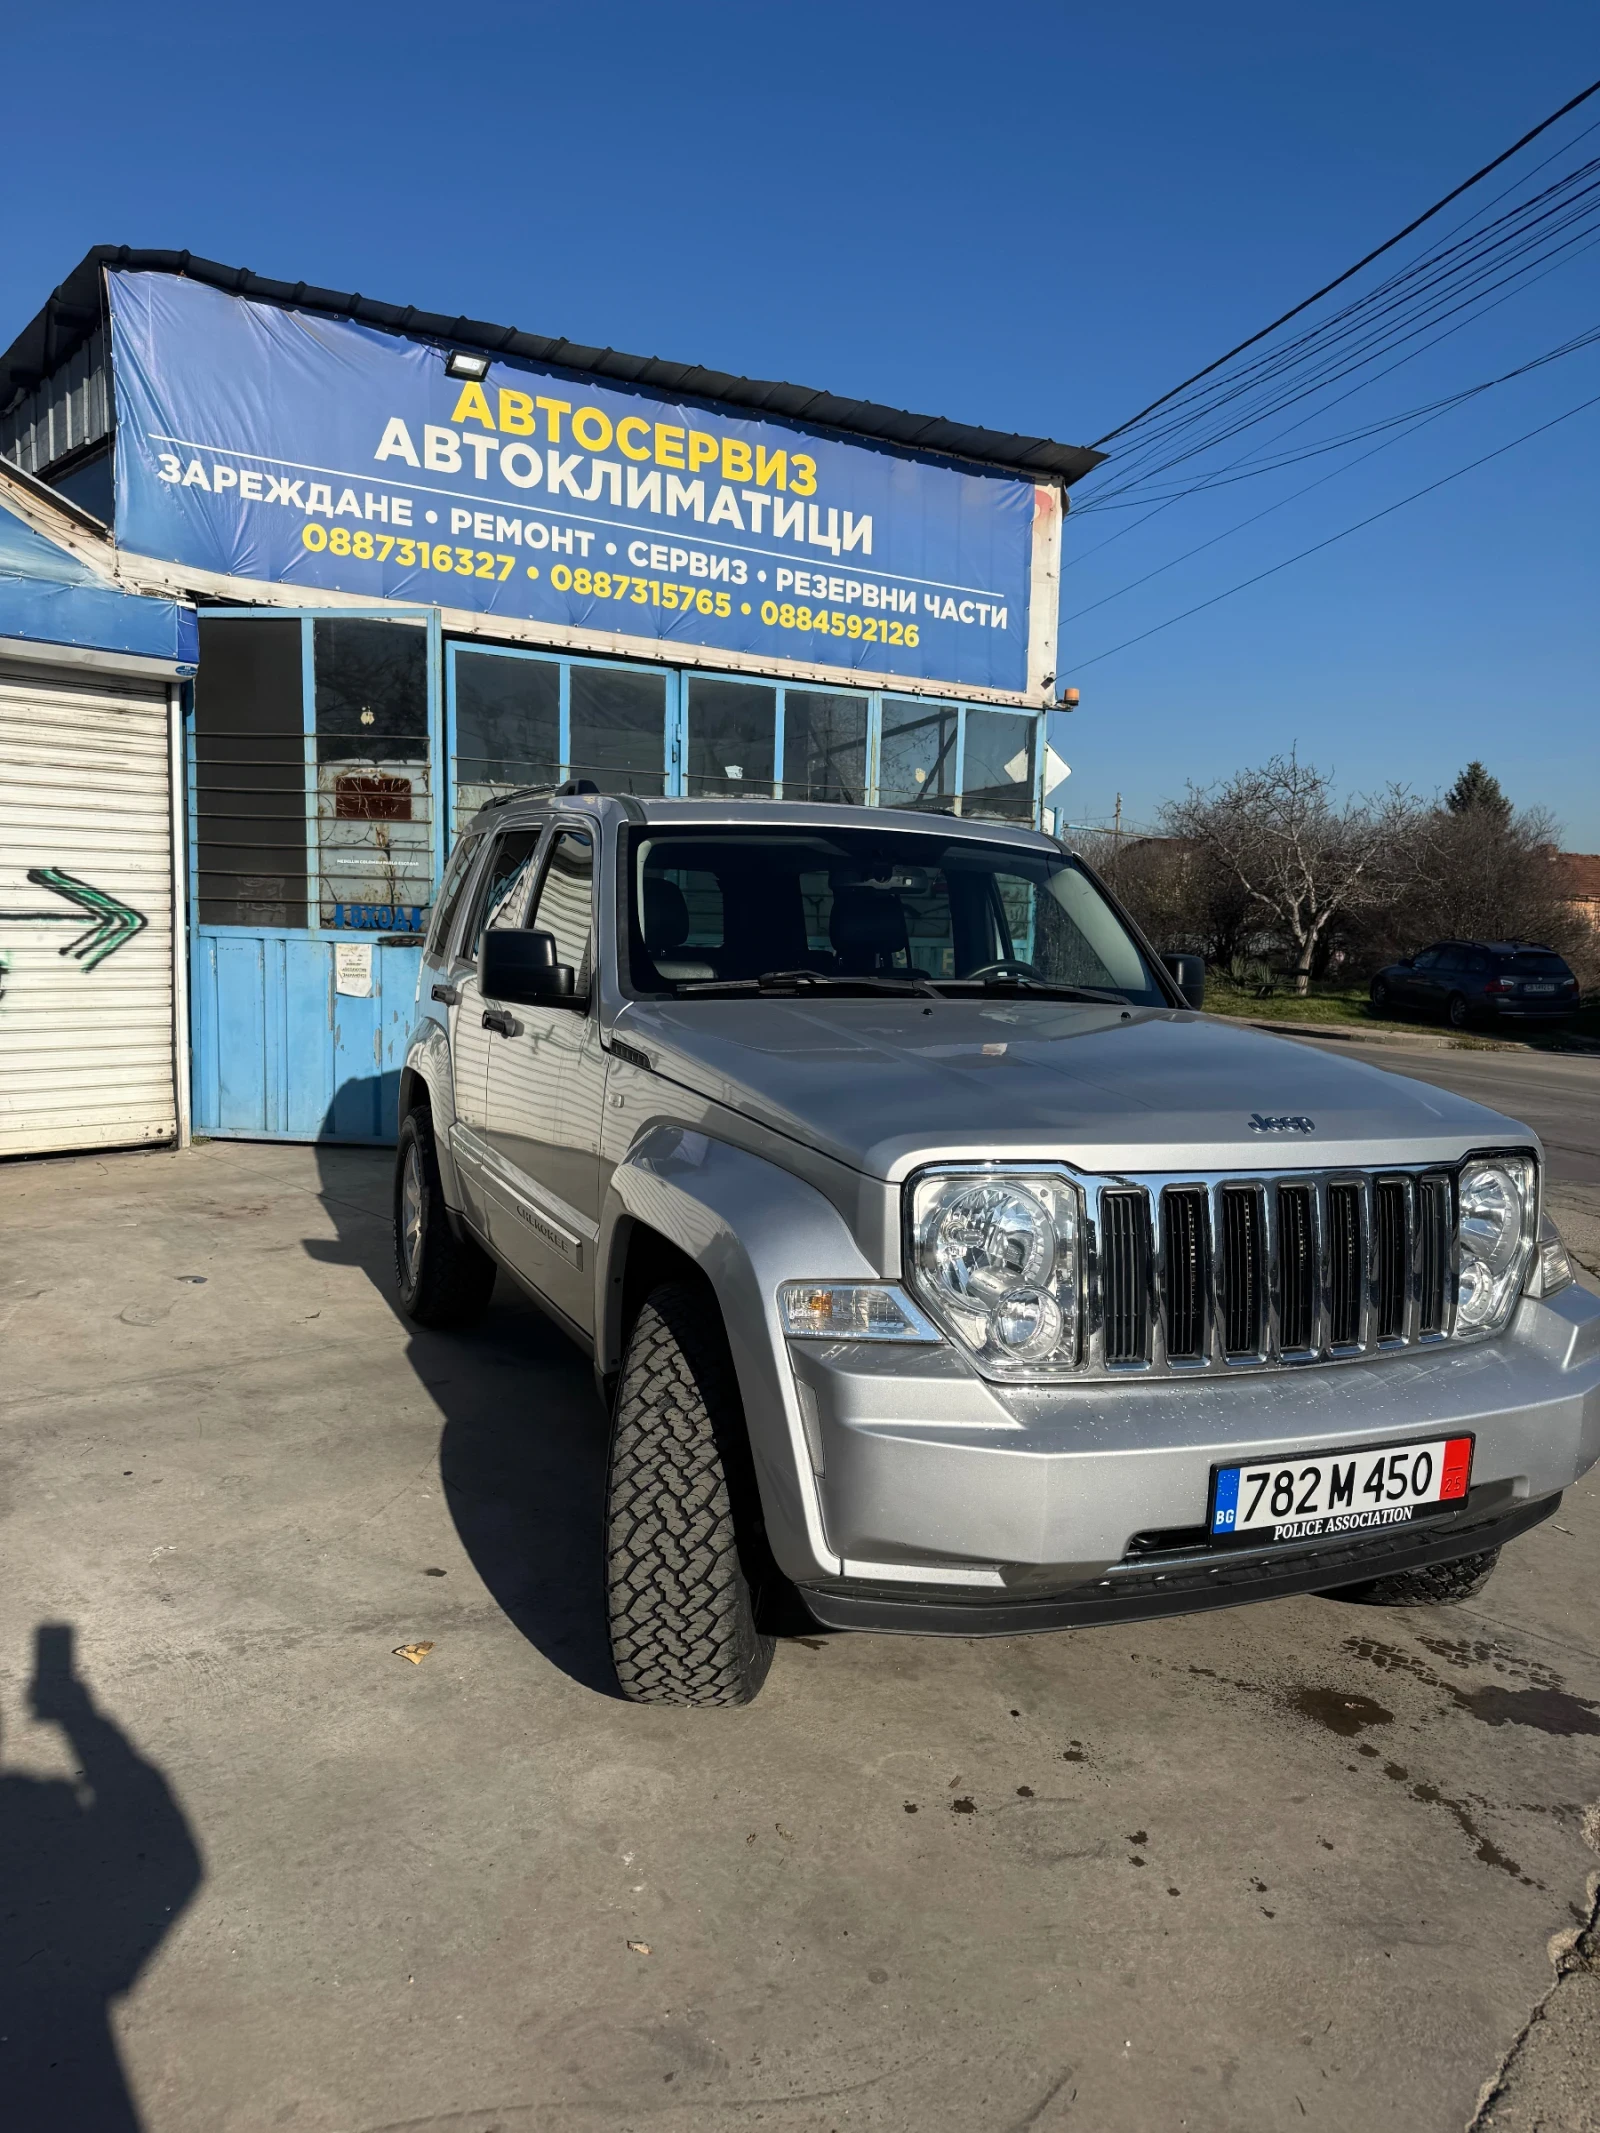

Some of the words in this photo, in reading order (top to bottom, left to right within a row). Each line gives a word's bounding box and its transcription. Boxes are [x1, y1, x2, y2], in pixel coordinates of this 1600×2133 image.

[451, 381, 817, 496] АВТОСЕРВИЗ
[374, 417, 873, 556] АВТОКЛИМАТИЦИ
[157, 453, 413, 527] ЗАРЕЖДАНЕ
[451, 507, 595, 558] РЕМОНТ
[627, 541, 748, 585] СЕРВИЗ
[776, 568, 917, 615] РЕЗЕРВНИ
[924, 593, 1008, 630] ЧАСТИ
[302, 522, 515, 582] 0887316327
[550, 564, 731, 618] 0887315765
[760, 600, 920, 648] 0884592126
[350, 904, 409, 932] ВХОД
[1247, 1113, 1316, 1136] Jeep
[517, 1205, 569, 1254] CHEROKEE
[1215, 1508, 1235, 1526] BG
[1243, 1466, 1322, 1522] 782
[1364, 1451, 1433, 1503] 450
[1445, 1477, 1461, 1493] 25
[1273, 1519, 1323, 1541] POLICE
[1325, 1505, 1415, 1532] ASSOCIATION
